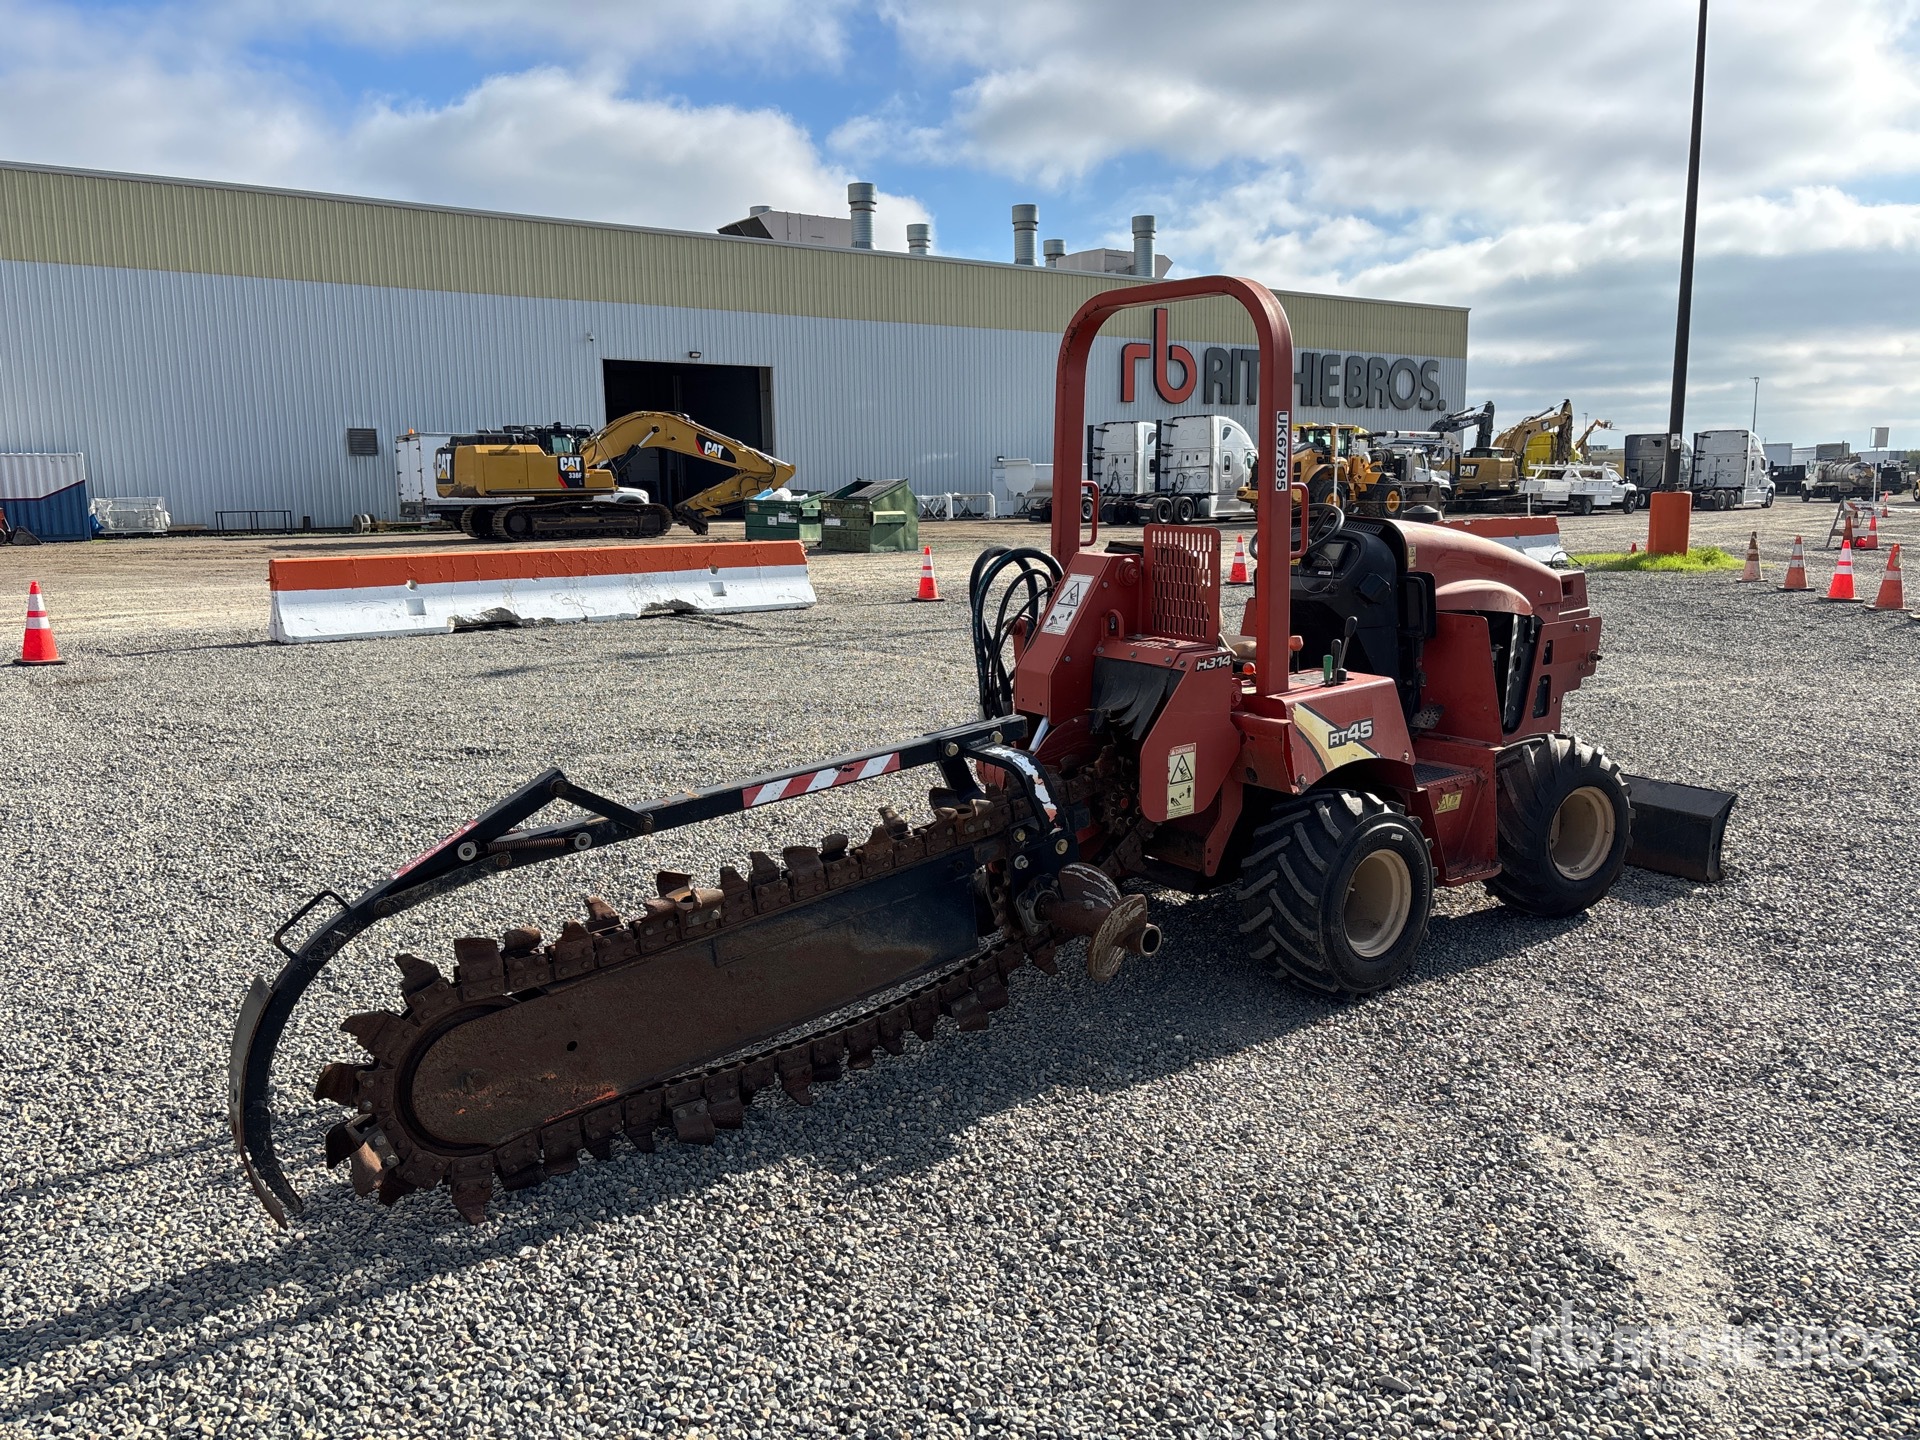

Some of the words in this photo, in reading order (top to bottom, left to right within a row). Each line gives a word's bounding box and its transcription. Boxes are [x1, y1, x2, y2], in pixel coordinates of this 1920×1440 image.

[1121, 308, 1198, 405] rb
[1203, 346, 1341, 408] RITHIE
[1344, 355, 1447, 412] BROS.
[704, 441, 724, 459] CAT
[1276, 411, 1288, 491] UK67595
[437, 453, 452, 479] CAT
[560, 456, 581, 472] CAT
[1460, 465, 1476, 477] CAT
[1196, 654, 1231, 671] H314
[1329, 720, 1373, 746] RT45
